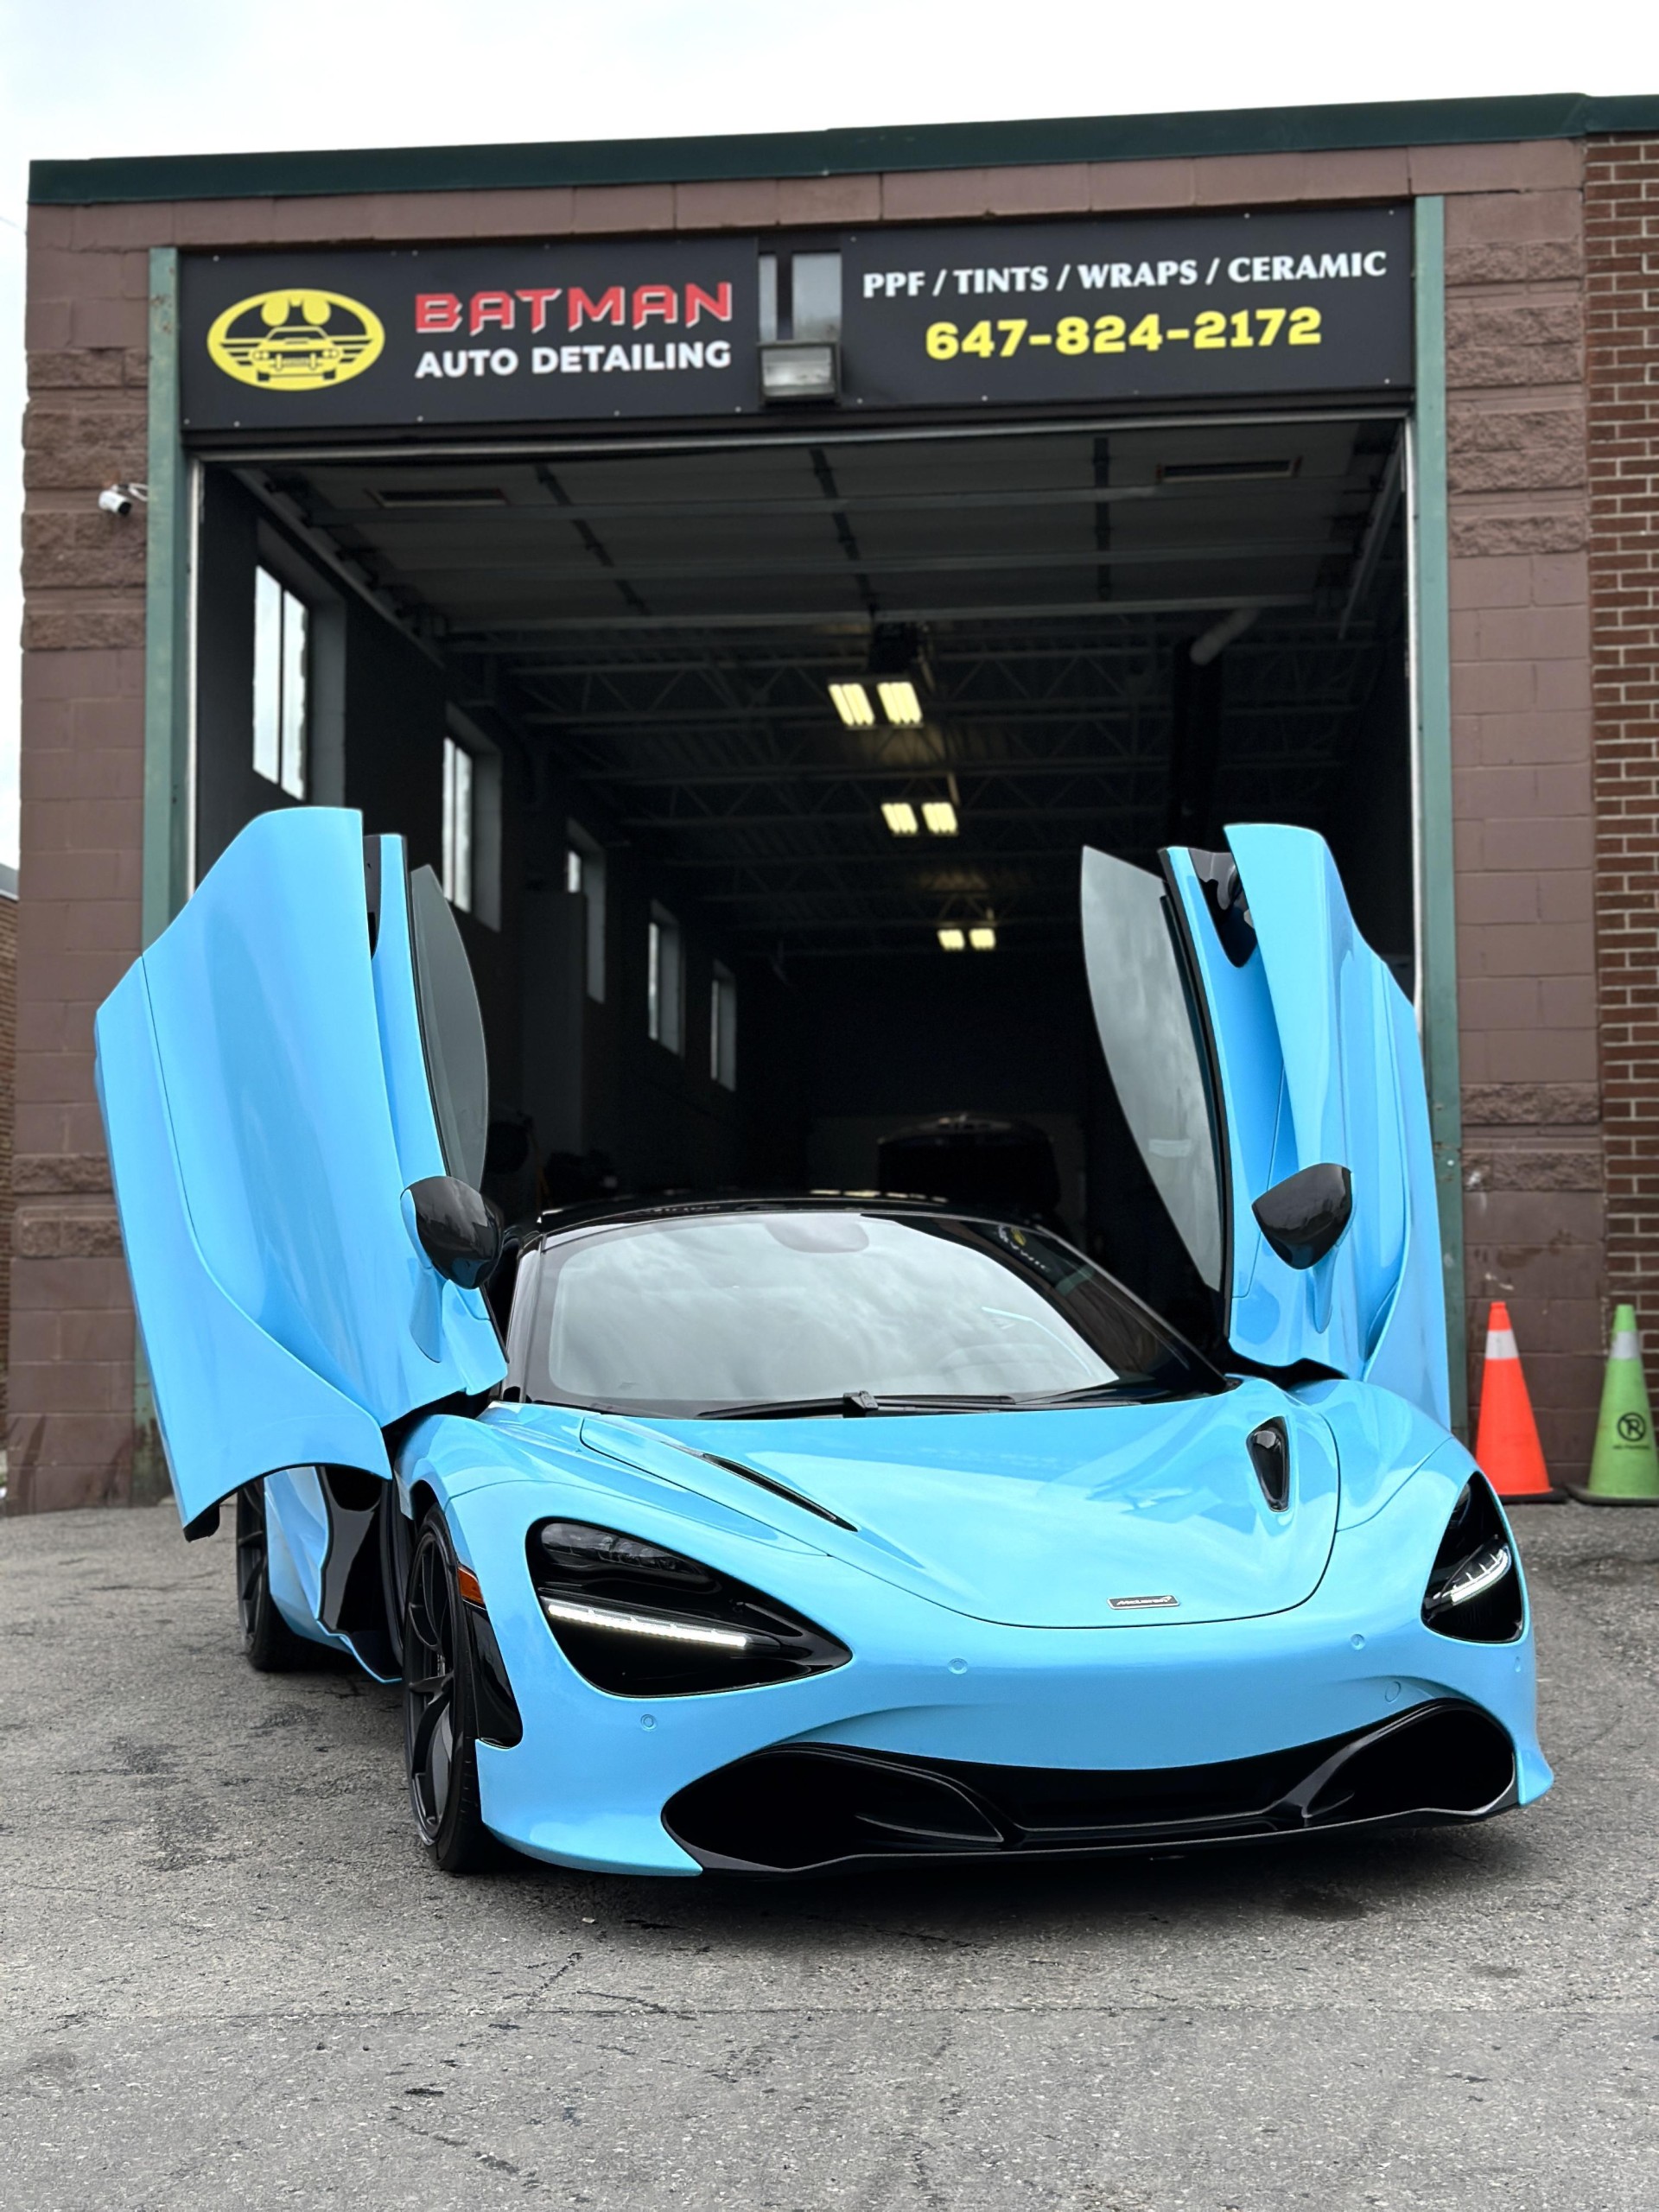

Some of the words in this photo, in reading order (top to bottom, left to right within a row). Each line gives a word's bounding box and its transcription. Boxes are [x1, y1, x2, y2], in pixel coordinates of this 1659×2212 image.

[862, 270, 925, 299] PPF
[952, 265, 1051, 296] TINTS
[1077, 258, 1199, 290] WRAPS
[1227, 250, 1388, 283] CERAMIC
[414, 281, 734, 337] BATMAN
[925, 306, 1322, 360] 647-824-2172
[414, 347, 519, 379] AUTO
[531, 340, 732, 375] DETAILING
